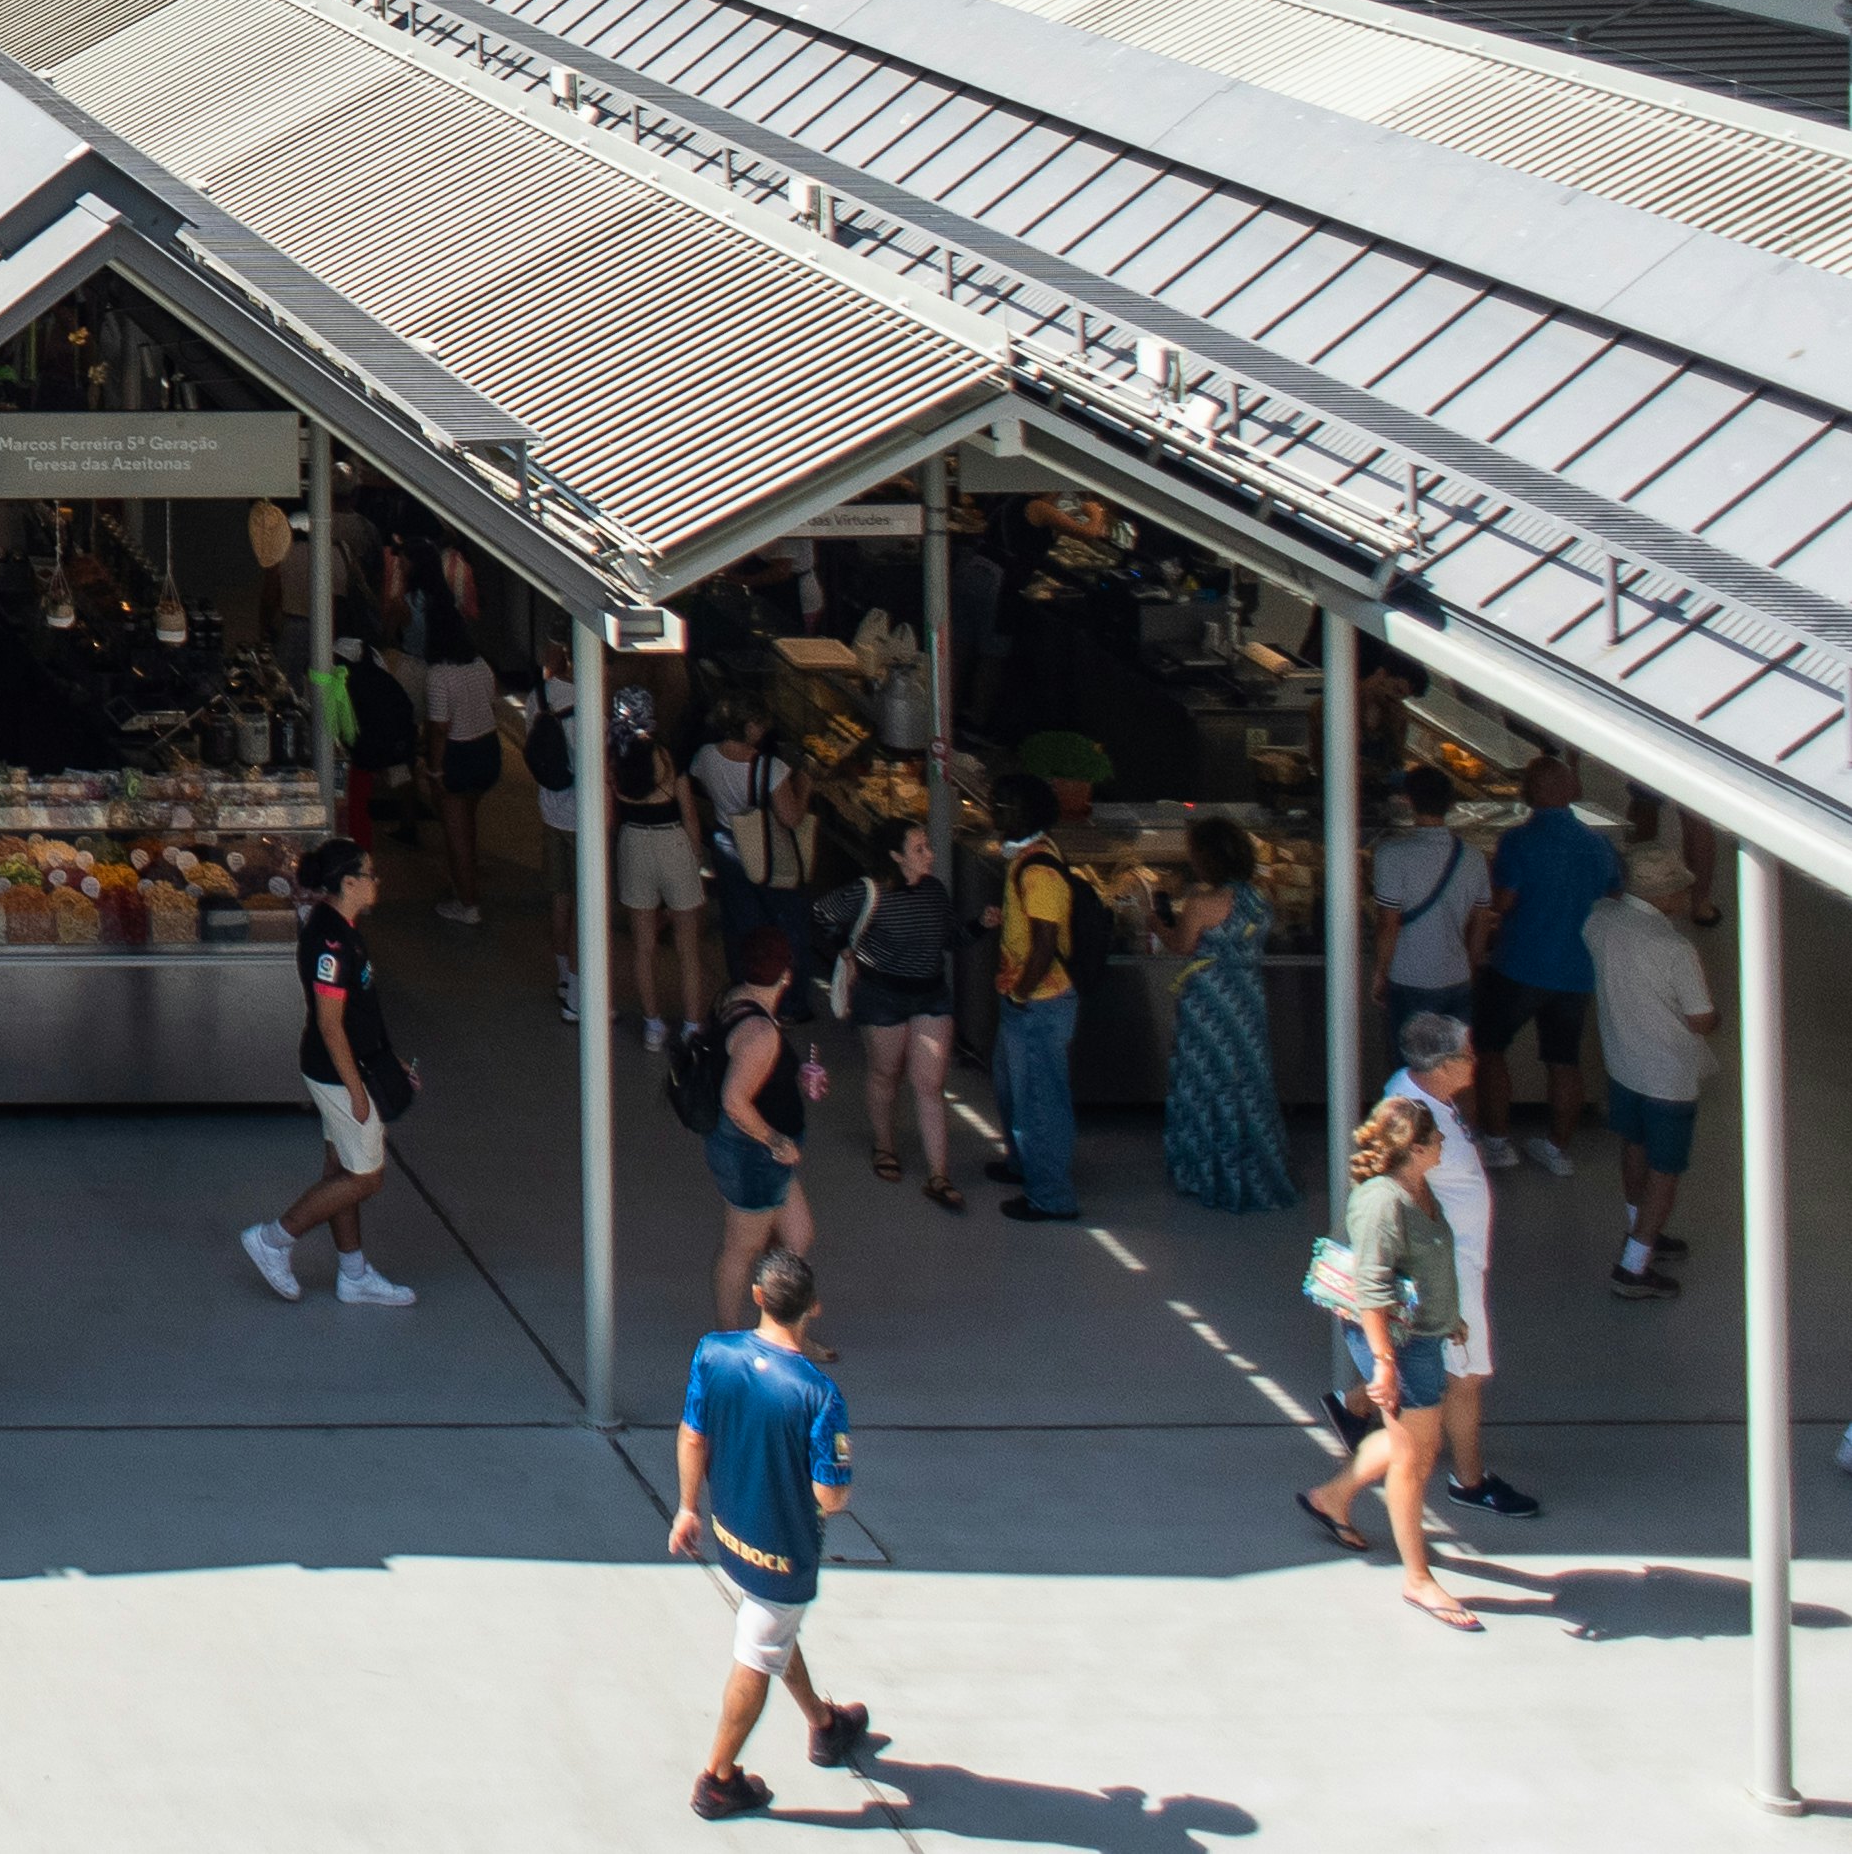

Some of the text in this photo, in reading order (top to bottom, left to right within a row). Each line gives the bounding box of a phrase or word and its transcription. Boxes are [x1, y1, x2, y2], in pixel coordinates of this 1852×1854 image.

[60, 436, 122, 451] Ferreira
[127, 436, 145, 451] 5ª
[149, 436, 218, 453] Geração
[25, 456, 192, 471] Teresa das Azeitonas
[834, 513, 890, 526] Virtudes
[740, 1541, 789, 1572] BOCK
